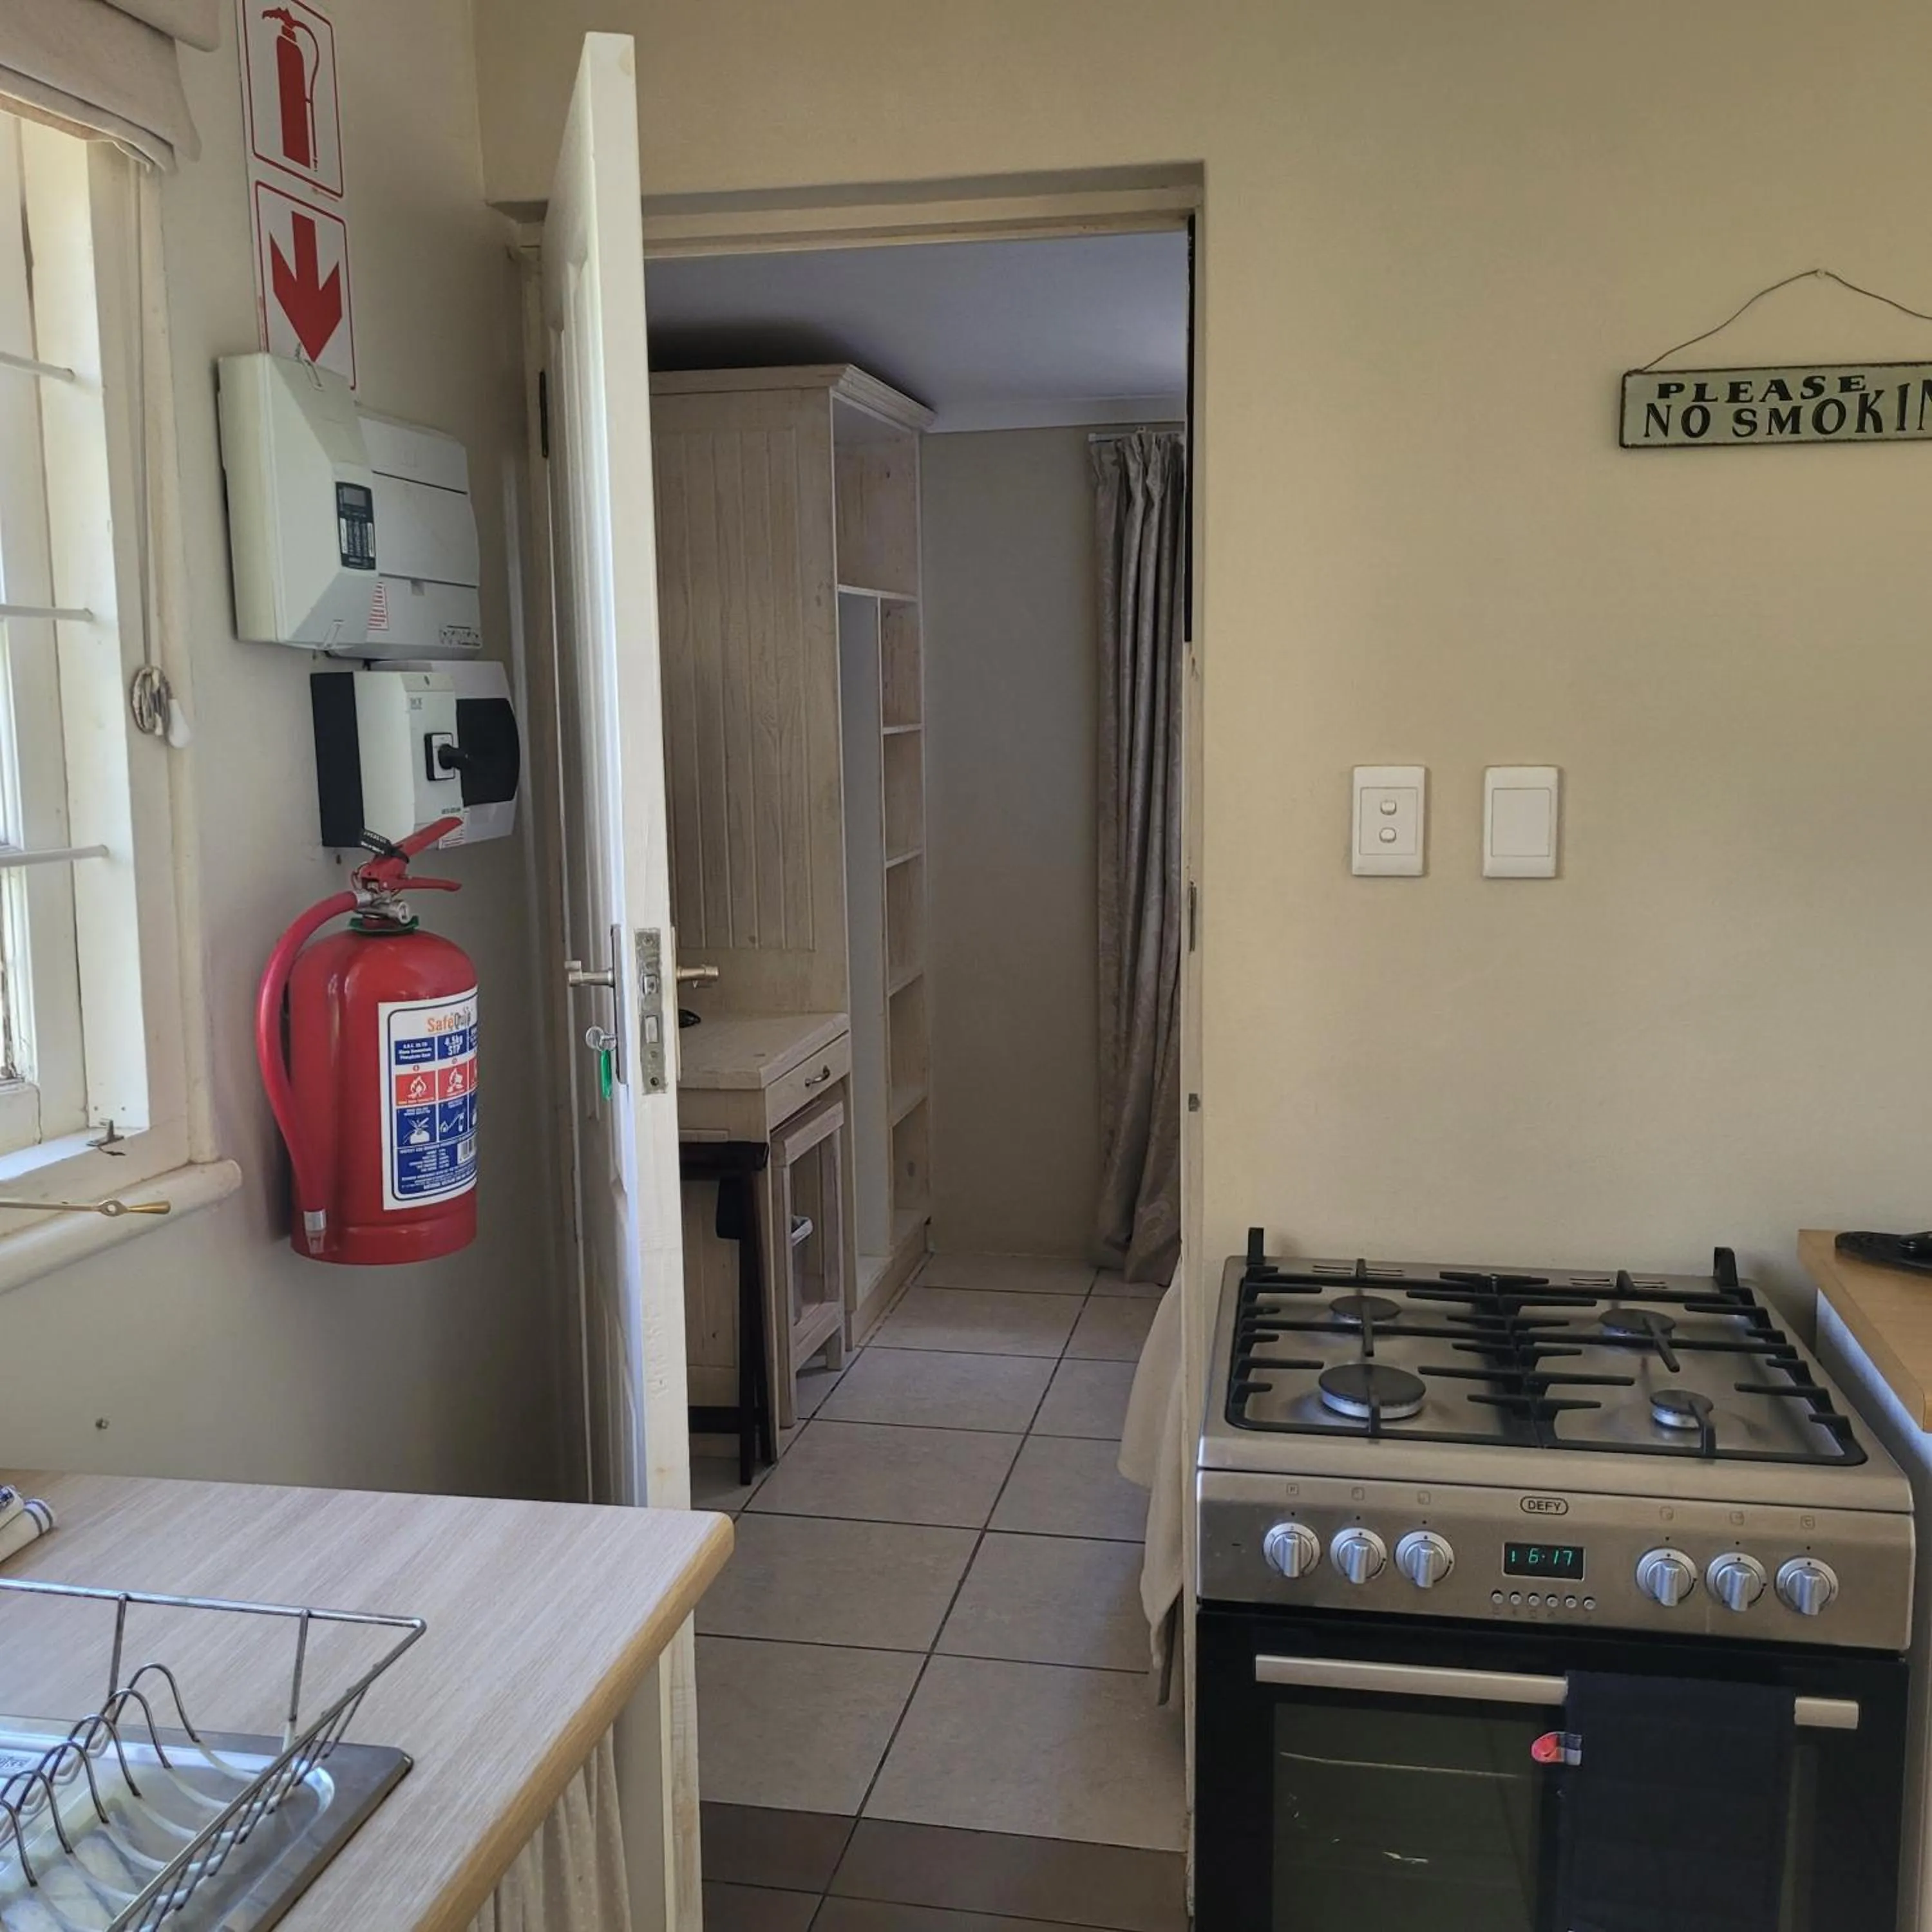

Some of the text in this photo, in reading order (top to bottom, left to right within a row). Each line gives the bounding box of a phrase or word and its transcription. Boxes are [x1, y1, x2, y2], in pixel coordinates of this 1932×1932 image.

[1657, 375, 1866, 403] PLEASE
[1643, 402, 1711, 439] NO
[1528, 1500, 1561, 1511] DEFY
